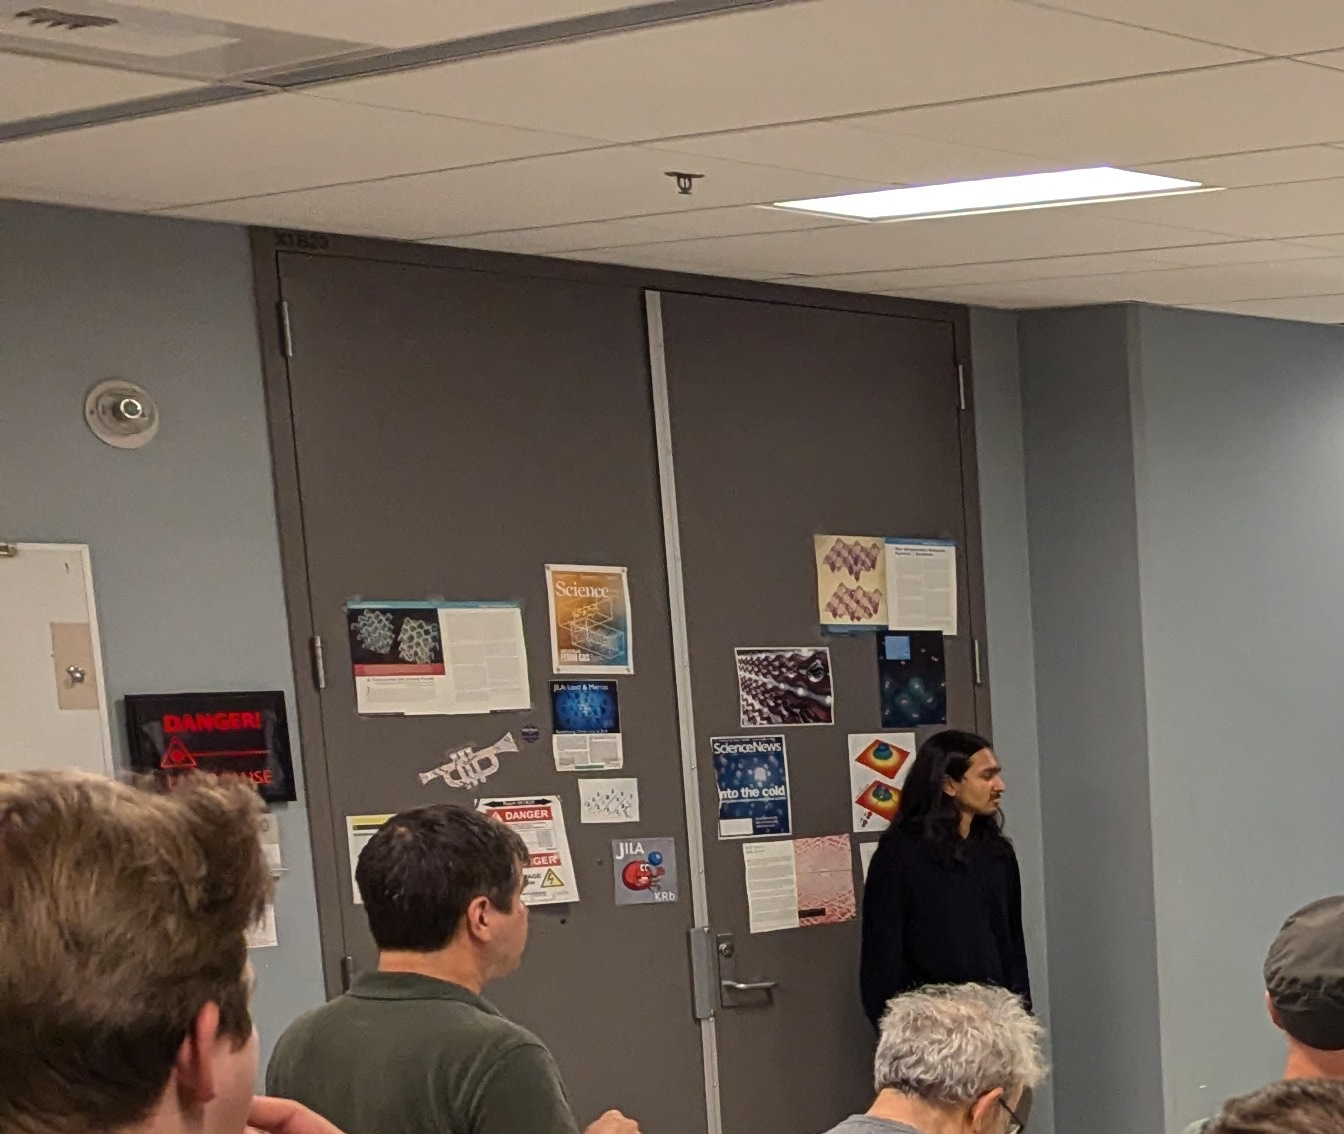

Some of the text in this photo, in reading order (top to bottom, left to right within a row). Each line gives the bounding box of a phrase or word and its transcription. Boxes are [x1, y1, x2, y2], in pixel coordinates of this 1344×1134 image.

[556, 581, 609, 598] Science
[162, 711, 262, 733] DANGER!
[714, 742, 782, 754] ScienceNews
[741, 787, 760, 798] the
[762, 785, 785, 796] cold
[505, 810, 549, 820] DANGER
[616, 842, 645, 860] JILA
[531, 855, 558, 866] GER
